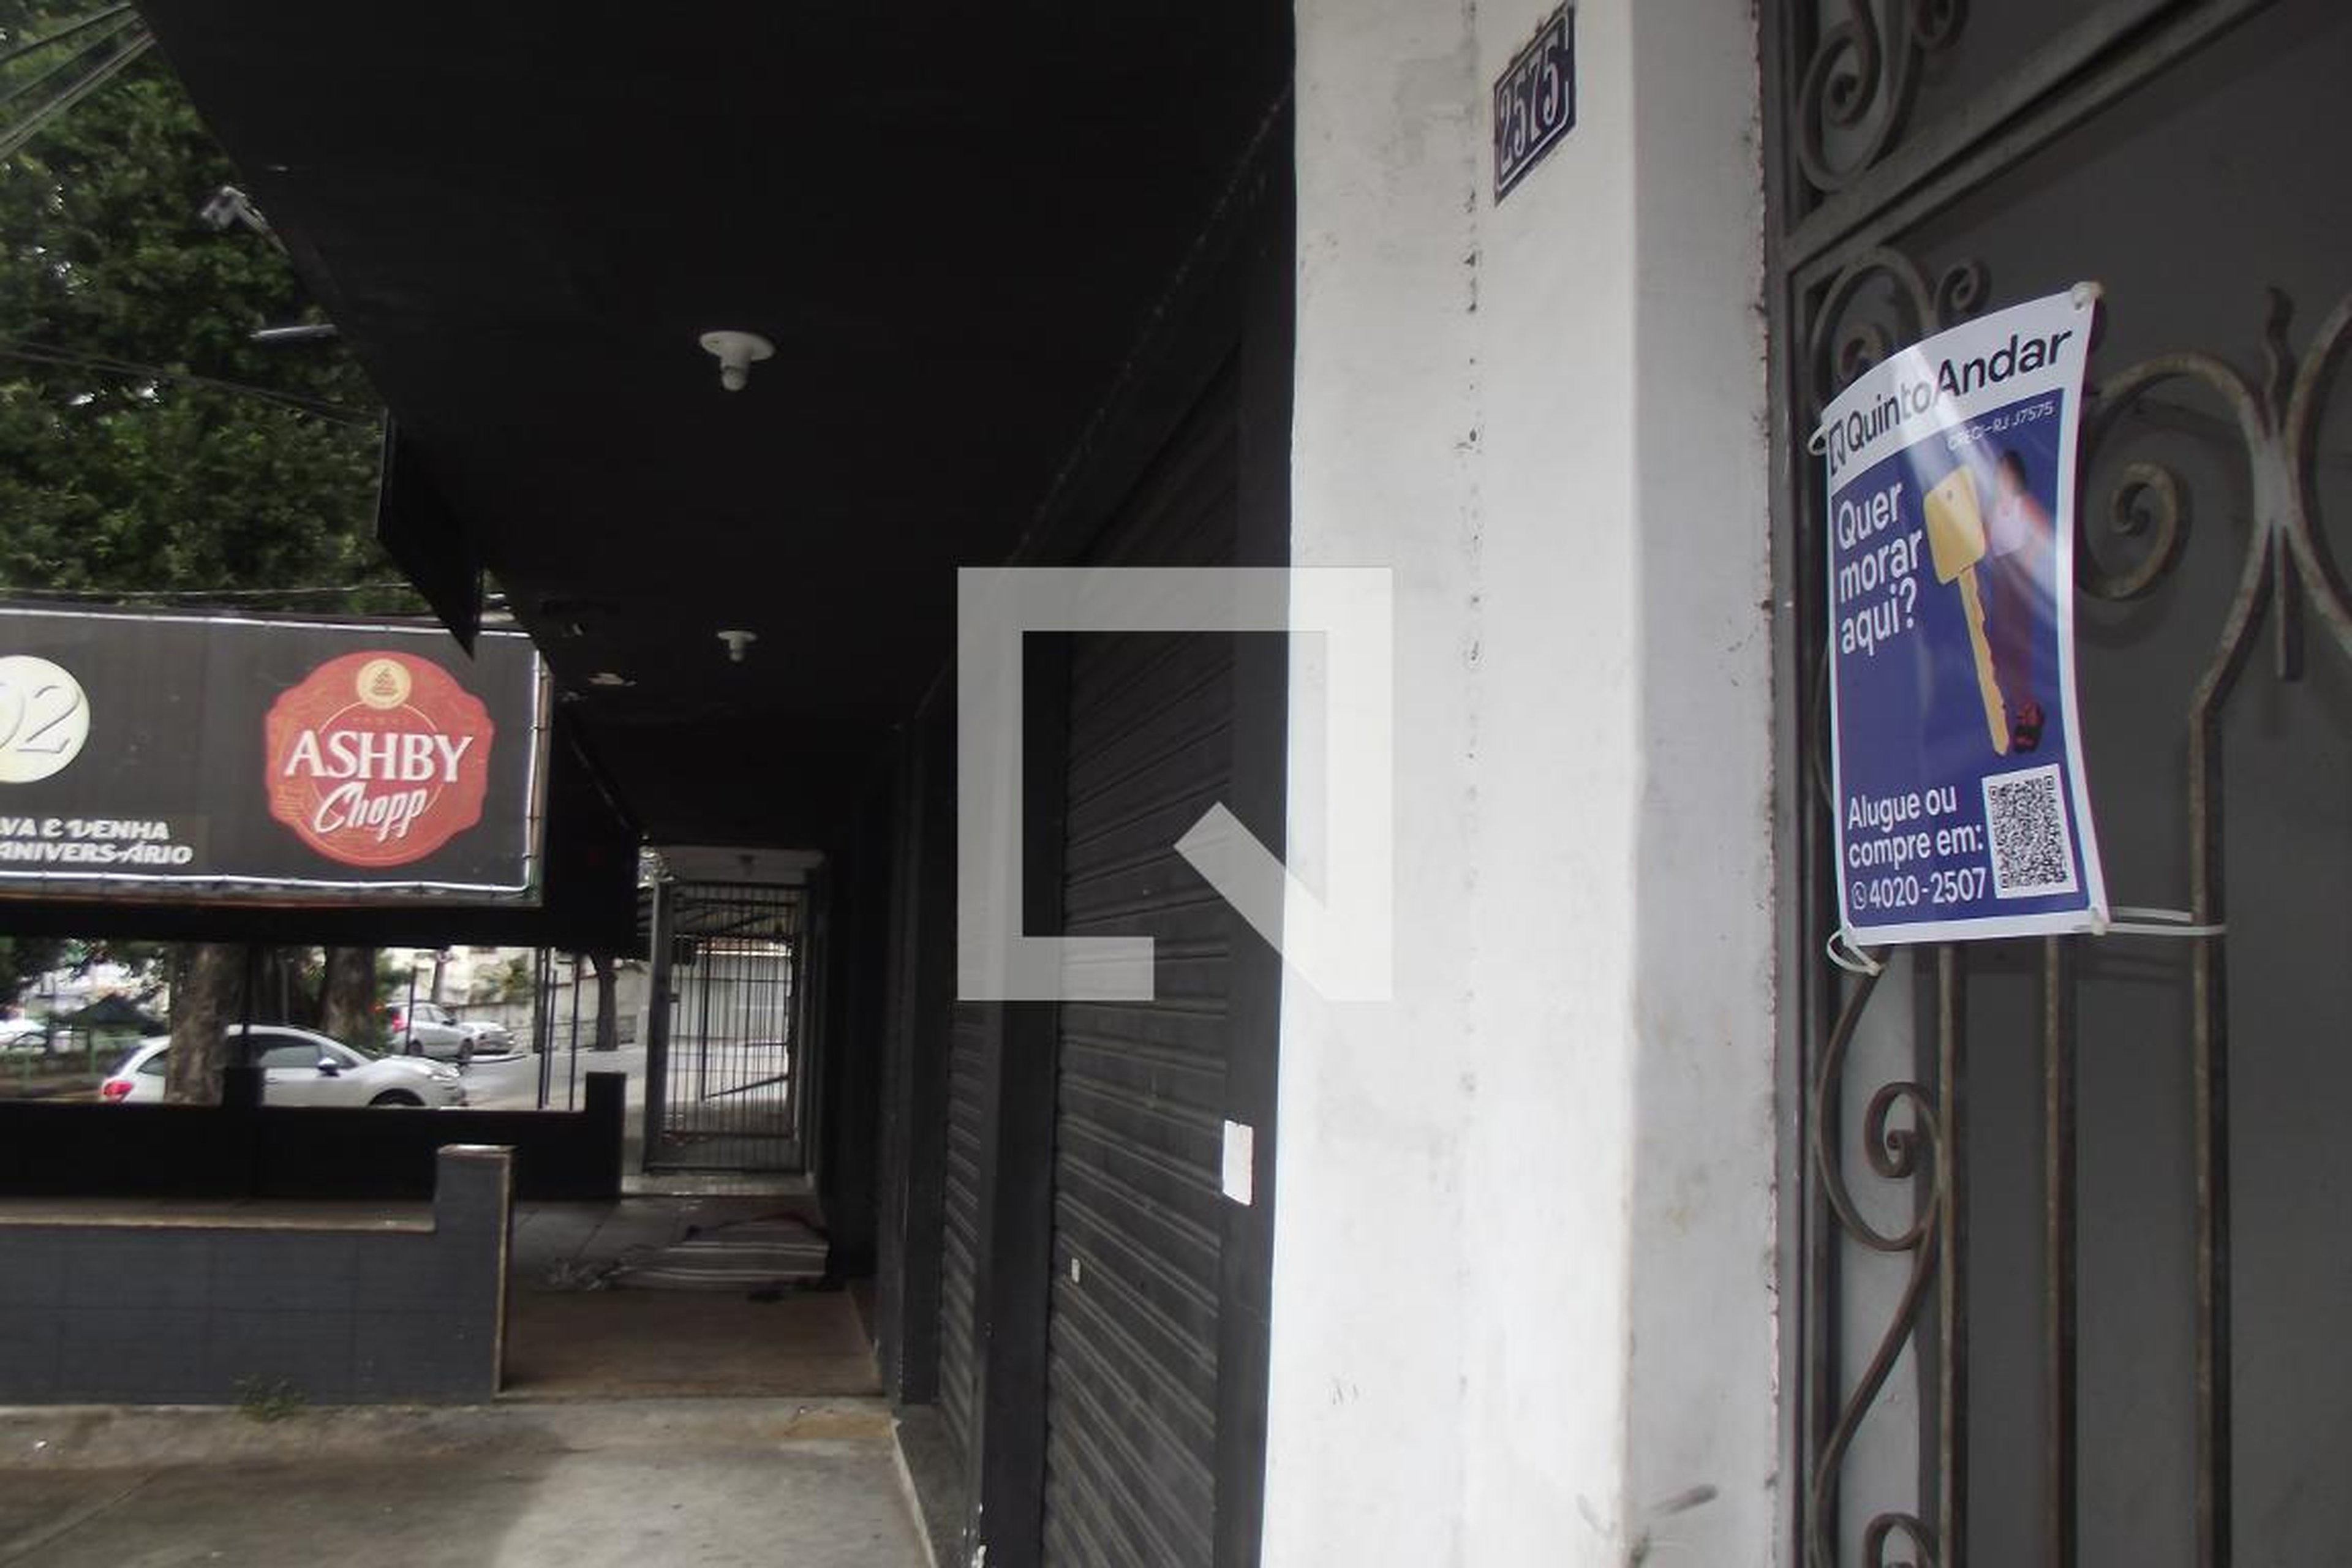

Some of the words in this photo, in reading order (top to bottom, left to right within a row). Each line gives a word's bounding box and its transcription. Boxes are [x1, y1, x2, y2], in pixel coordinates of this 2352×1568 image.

[1501, 29, 1559, 176] 2575
[1847, 330, 2073, 452] QuintoAndar
[1838, 481, 1902, 550] Quer
[1840, 529, 1923, 604] morar
[1841, 576, 1918, 657] aqui?
[284, 729, 474, 783] ASHBY
[313, 781, 429, 842] Chopp
[1847, 788, 1921, 833] Alugue
[1926, 785, 1958, 816] ou
[1849, 829, 1931, 870] compre
[1937, 823, 1984, 856] em:
[1869, 867, 1986, 910] 4020-2507
